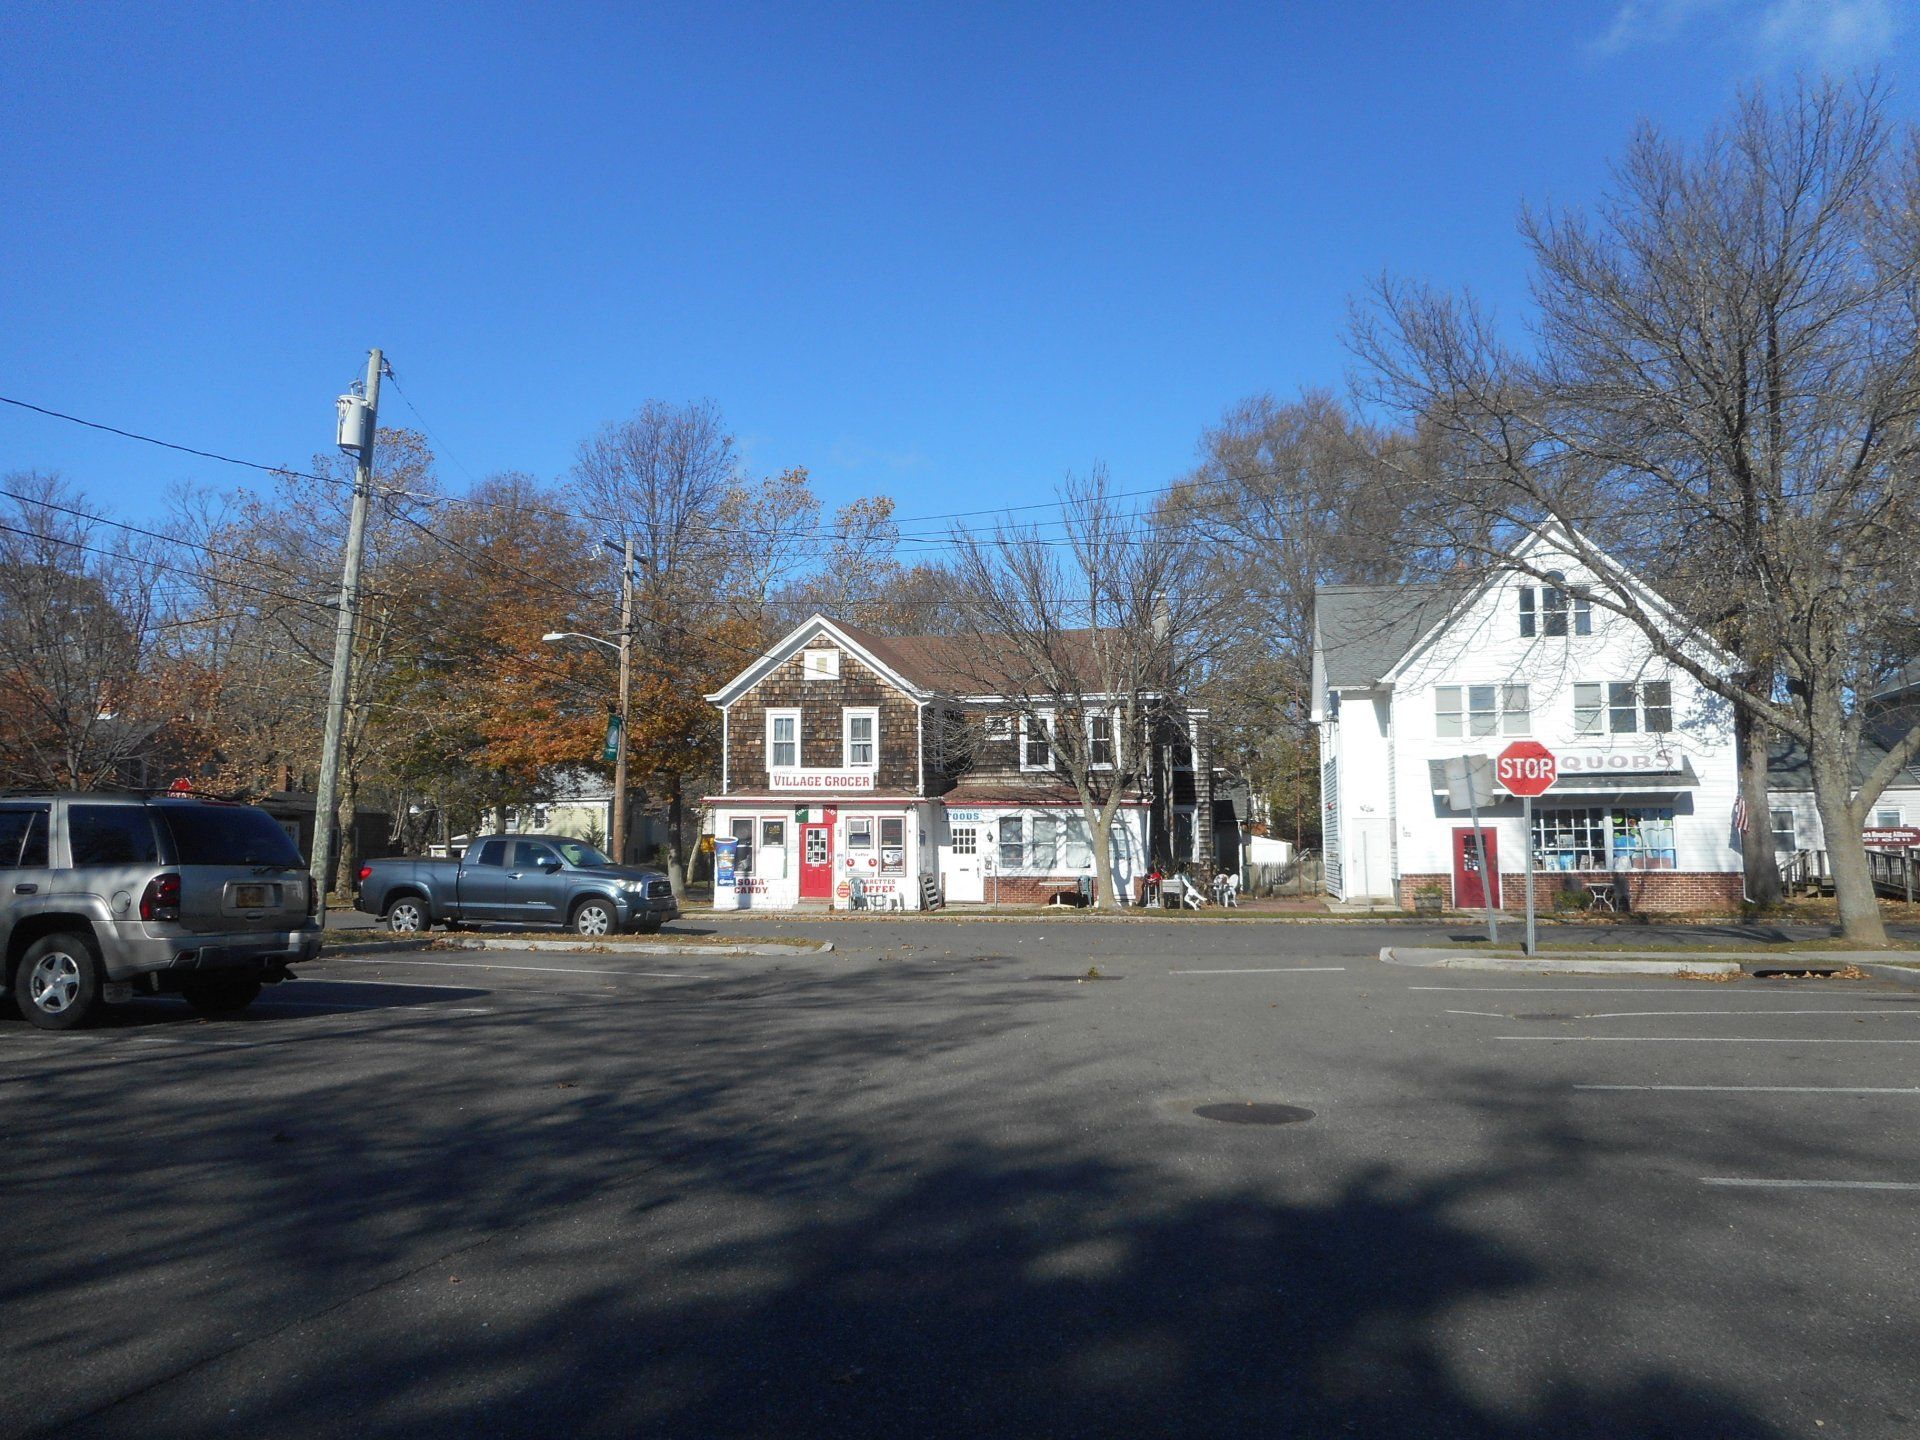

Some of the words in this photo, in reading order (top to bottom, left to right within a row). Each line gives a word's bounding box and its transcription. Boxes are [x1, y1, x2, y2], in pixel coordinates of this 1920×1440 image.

[1561, 749, 1674, 771] QUORS
[1501, 757, 1553, 779] STOP
[774, 775, 822, 787] VILLAGE
[825, 775, 870, 787] GROCER
[946, 812, 980, 821] FOODS
[737, 878, 765, 886] SODA
[734, 886, 769, 894] CANDY
[863, 885, 896, 893] OFFEE
